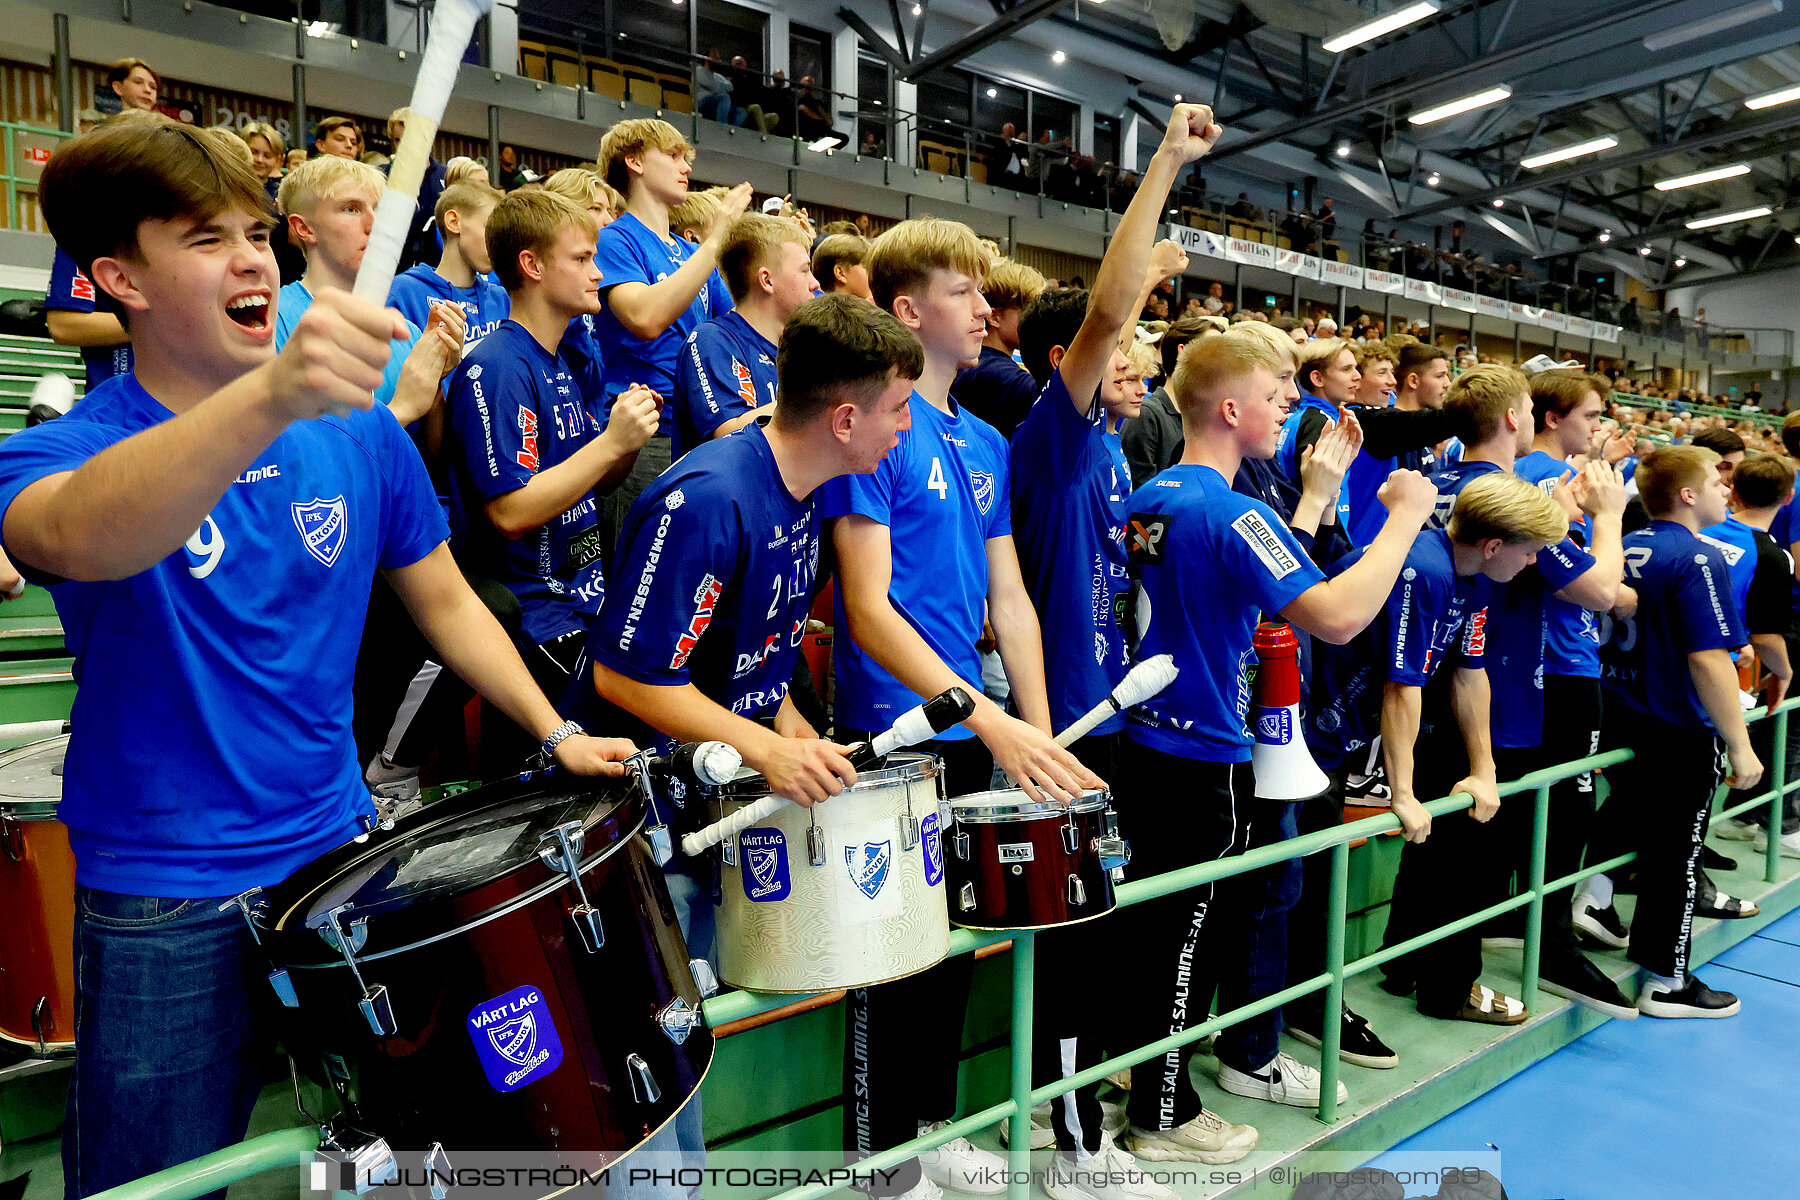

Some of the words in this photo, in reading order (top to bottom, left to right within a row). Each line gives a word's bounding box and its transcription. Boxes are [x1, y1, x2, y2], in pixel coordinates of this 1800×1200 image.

[1179, 230, 1201, 248] VIP
[690, 342, 720, 415] COMPASSEN.NU
[472, 380, 500, 478] COMPASSEN.NU
[927, 456, 949, 500] 4
[304, 511, 324, 523] IFK
[310, 510, 341, 544] SKÖVDE
[1245, 513, 1295, 570] CEMENTA
[619, 514, 672, 652] COMPASSEN.NU
[696, 576, 714, 602] SKÖVDE
[766, 573, 783, 621] 2
[1701, 565, 1731, 637] COMPASSEN.NU
[1395, 583, 1412, 670] COMPASSEN.NU
[1280, 709, 1290, 728] VÅRT
[1281, 728, 1289, 743] LAG
[741, 835, 763, 846] VÅRT
[764, 834, 783, 845] LAG
[470, 1004, 508, 1029] VÅRT
[510, 991, 539, 1013] LAG
[497, 1029, 515, 1041] IFK
[506, 1024, 530, 1054] SKÖVDE
[504, 1048, 550, 1086] Handboll
